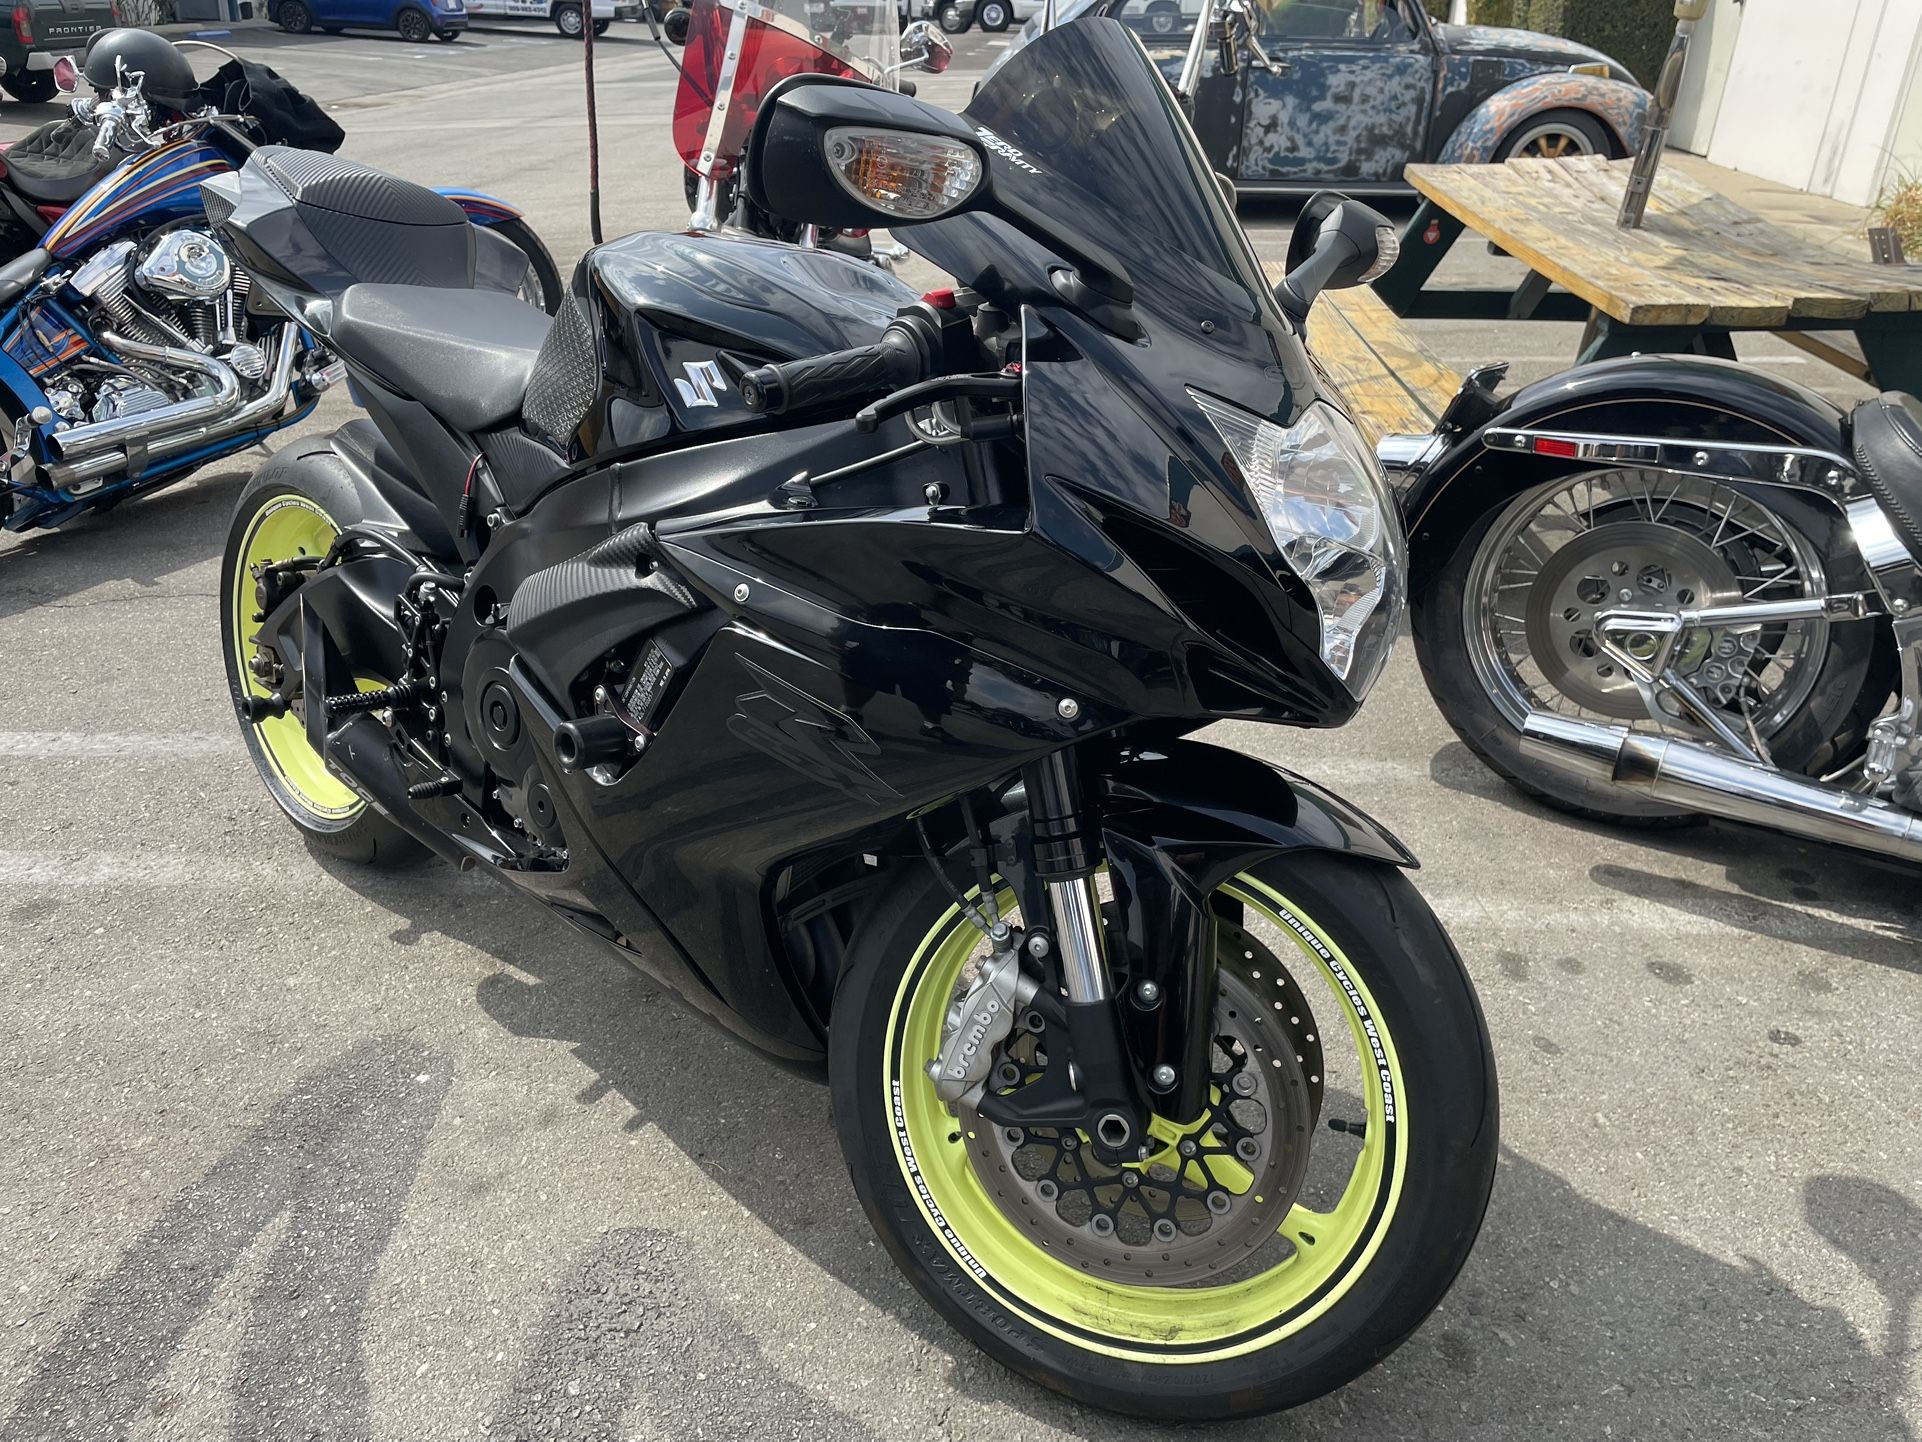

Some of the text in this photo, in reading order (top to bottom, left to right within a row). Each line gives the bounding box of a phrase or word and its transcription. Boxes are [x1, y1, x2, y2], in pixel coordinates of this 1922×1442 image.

[49, 25, 102, 34] FRONTIER
[976, 126, 1024, 157] ZERO
[980, 136, 1043, 174] GRAVITY
[328, 758, 390, 816] TOCE
[947, 999, 1000, 1079] brembo
[1278, 908, 1395, 1123] Unique Cycles West Coast
[892, 1079, 904, 1128] Coast
[898, 1131, 918, 1173] West
[914, 1175, 946, 1228] Cycles
[944, 1228, 987, 1279] Unique
